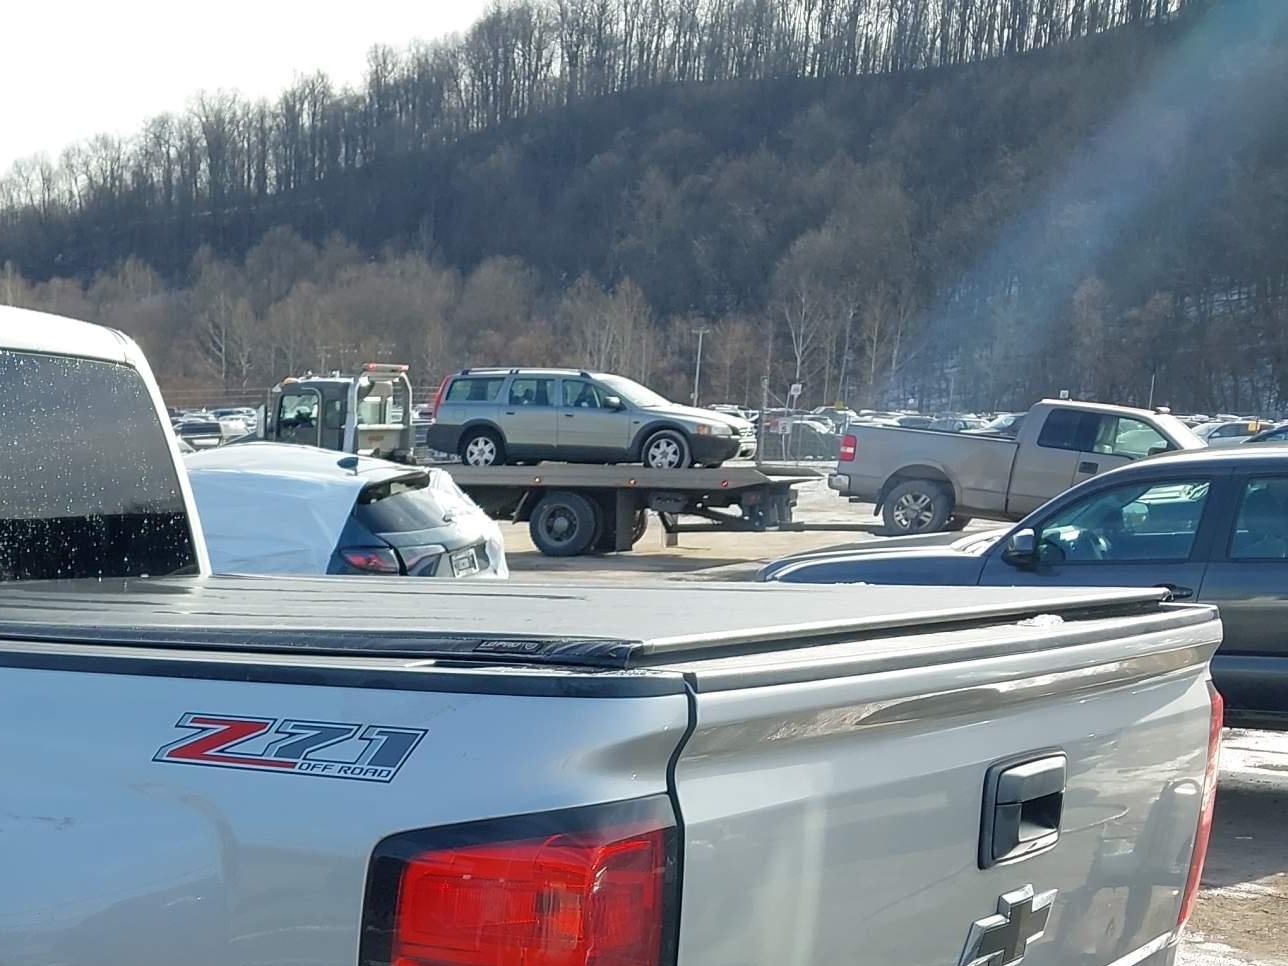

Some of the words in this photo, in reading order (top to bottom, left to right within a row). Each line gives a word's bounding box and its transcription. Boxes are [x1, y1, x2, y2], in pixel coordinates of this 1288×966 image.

[152, 711, 429, 781] Z71
[298, 761, 333, 774] OFF
[337, 765, 392, 779] ROAD
